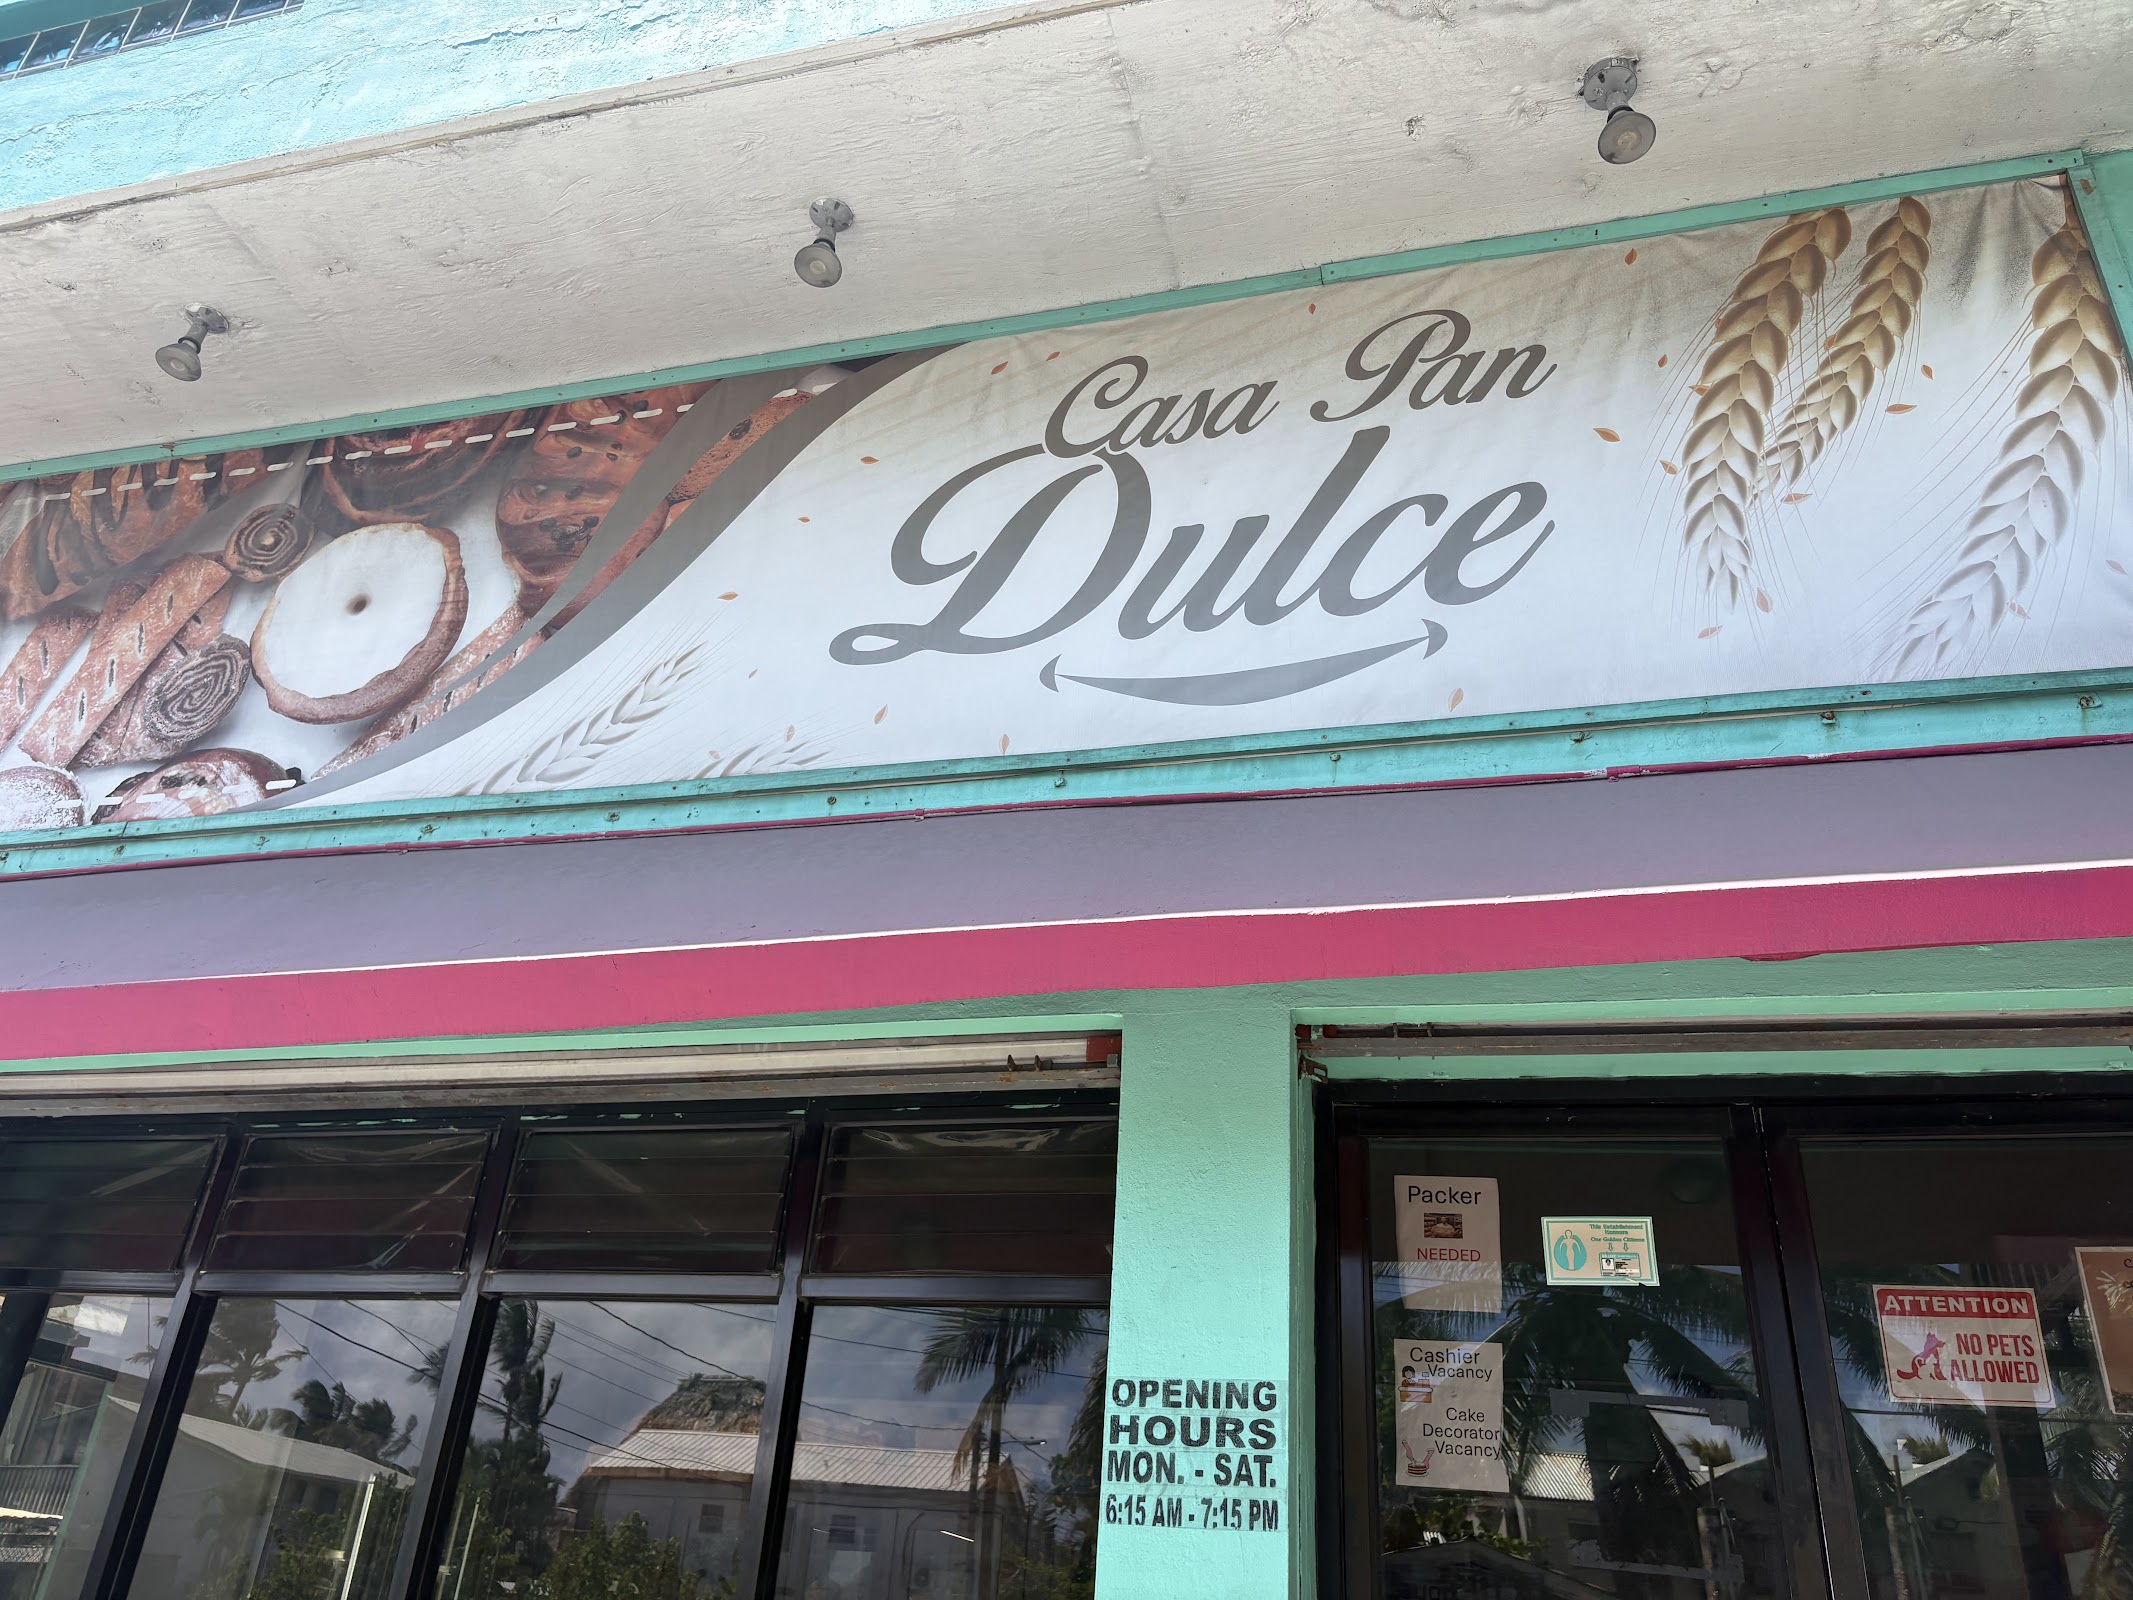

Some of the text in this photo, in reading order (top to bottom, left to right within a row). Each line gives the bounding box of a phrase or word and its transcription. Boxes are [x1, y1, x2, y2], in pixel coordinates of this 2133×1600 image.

[1044, 308, 1558, 459] Casa Pan
[828, 425, 1556, 667] Dulce
[1408, 1185, 1482, 1205] Packer
[1417, 1247, 1481, 1262] NEEDED
[1884, 1295, 2029, 1315] ATTENTION
[1410, 1346, 1480, 1365] Cashier
[1955, 1333, 2034, 1357] NO PETS
[1427, 1363, 1493, 1382] Vacancy
[1950, 1359, 2040, 1384] ALLOWED
[1112, 1378, 1277, 1412] OPENING
[1446, 1407, 1485, 1423] Cake
[1109, 1414, 1277, 1450] HOURS
[1423, 1423, 1500, 1440] Decorator
[1435, 1440, 1501, 1460] Vacancy
[1107, 1450, 1185, 1485] MON.
[1213, 1453, 1277, 1488] SAT.
[1105, 1494, 1146, 1526] 6:15
[1152, 1497, 1183, 1527] AM
[1200, 1497, 1243, 1530] 7:15
[1248, 1498, 1279, 1532] PM
